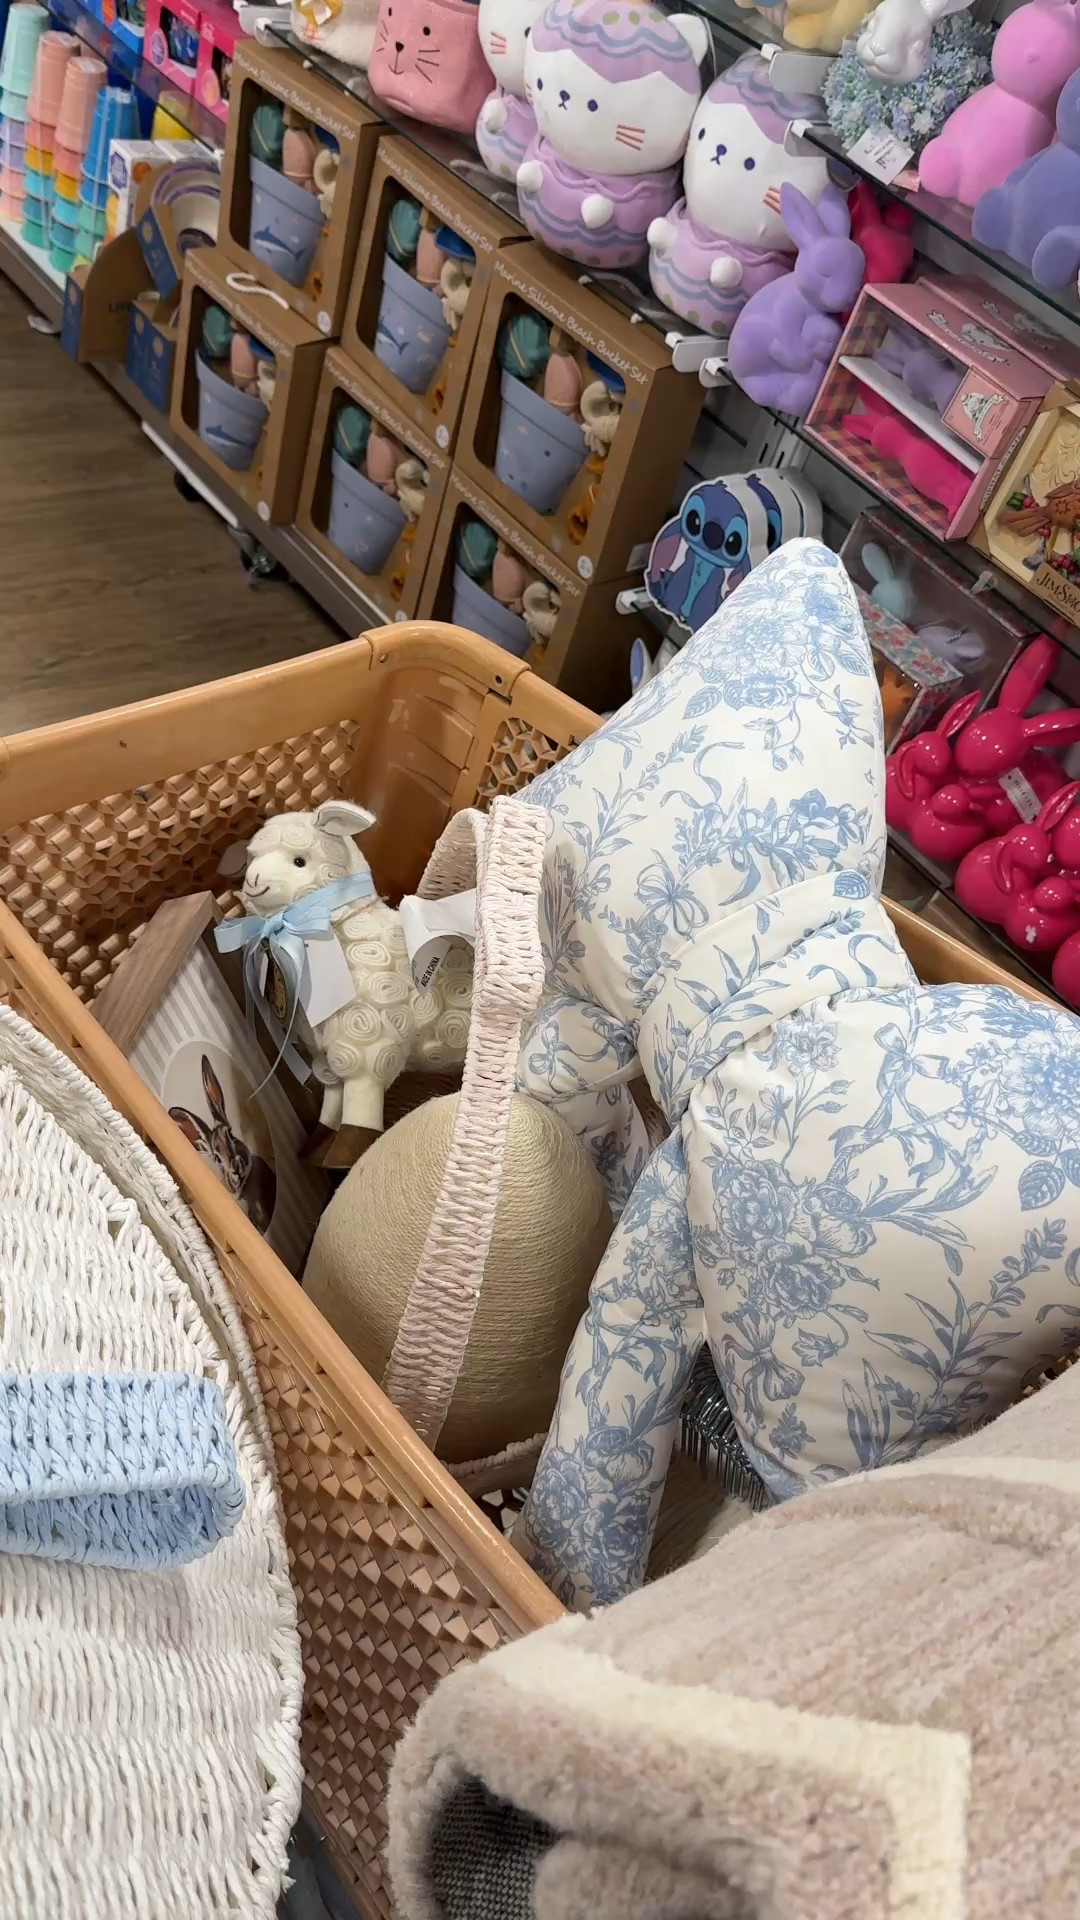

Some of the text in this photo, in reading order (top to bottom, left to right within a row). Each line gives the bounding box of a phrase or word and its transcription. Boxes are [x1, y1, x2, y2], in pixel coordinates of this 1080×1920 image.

[494, 261, 648, 384] Marine Silicone Beach Bucket Set
[510, 530, 537, 559] Beach
[536, 554, 566, 583] Bucket
[566, 580, 580, 597] Set
[1036, 572, 1060, 595] JIM
[421, 974, 431, 987] MADE
[428, 957, 440, 971] CHINA
